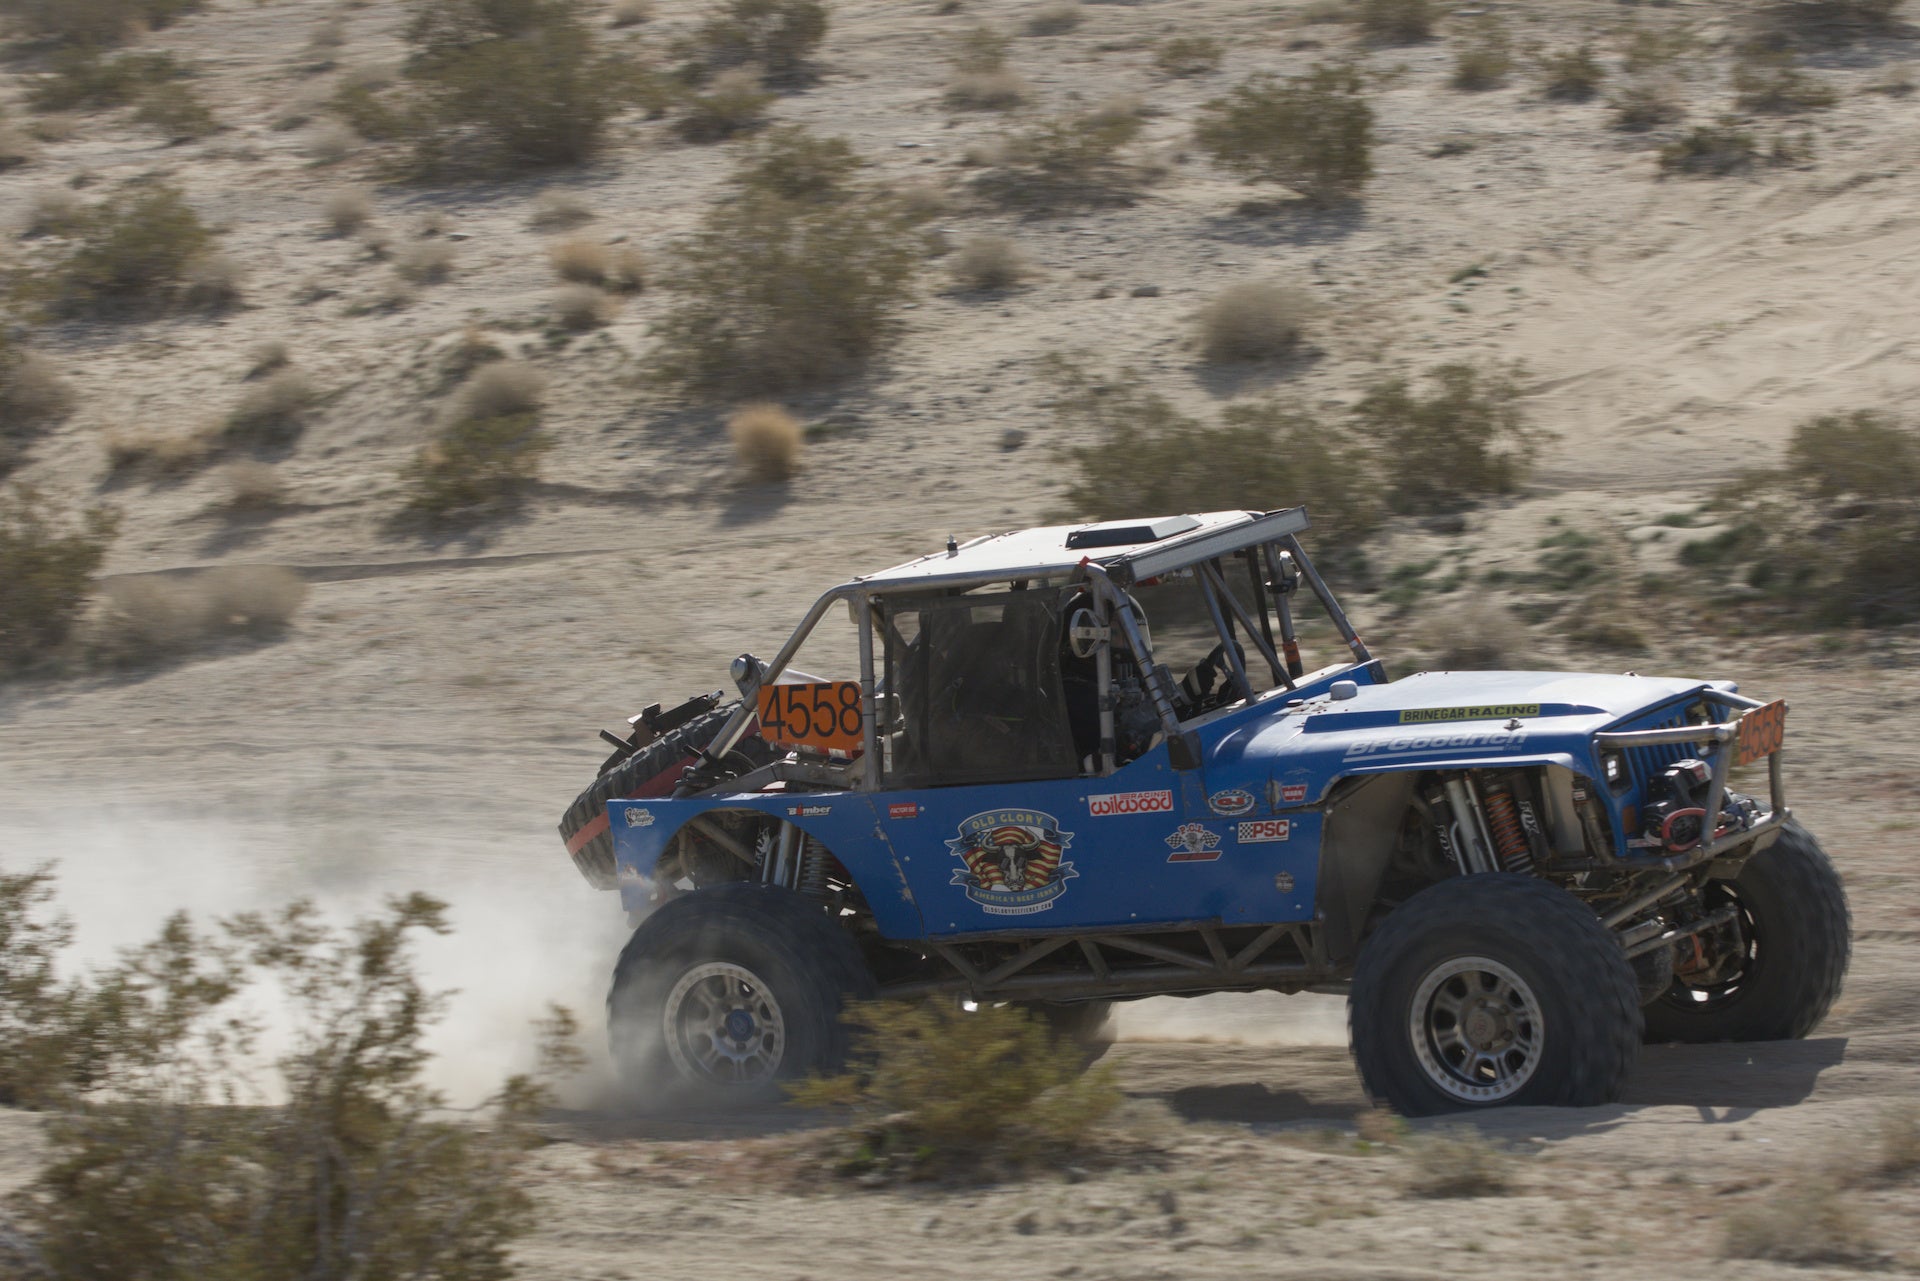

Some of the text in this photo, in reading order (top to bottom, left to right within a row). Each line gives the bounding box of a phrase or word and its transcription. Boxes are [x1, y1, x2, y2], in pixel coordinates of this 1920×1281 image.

[762, 682, 863, 739] 4558
[1403, 705, 1537, 721] BRINEGAR RACING
[1741, 702, 1784, 762] 4558
[1346, 731, 1528, 755] BFGoodrich
[1091, 791, 1172, 815] wilwood
[1130, 791, 1167, 799] RACING
[972, 813, 1043, 829] OLD GLORY
[1252, 821, 1289, 838] PSC
